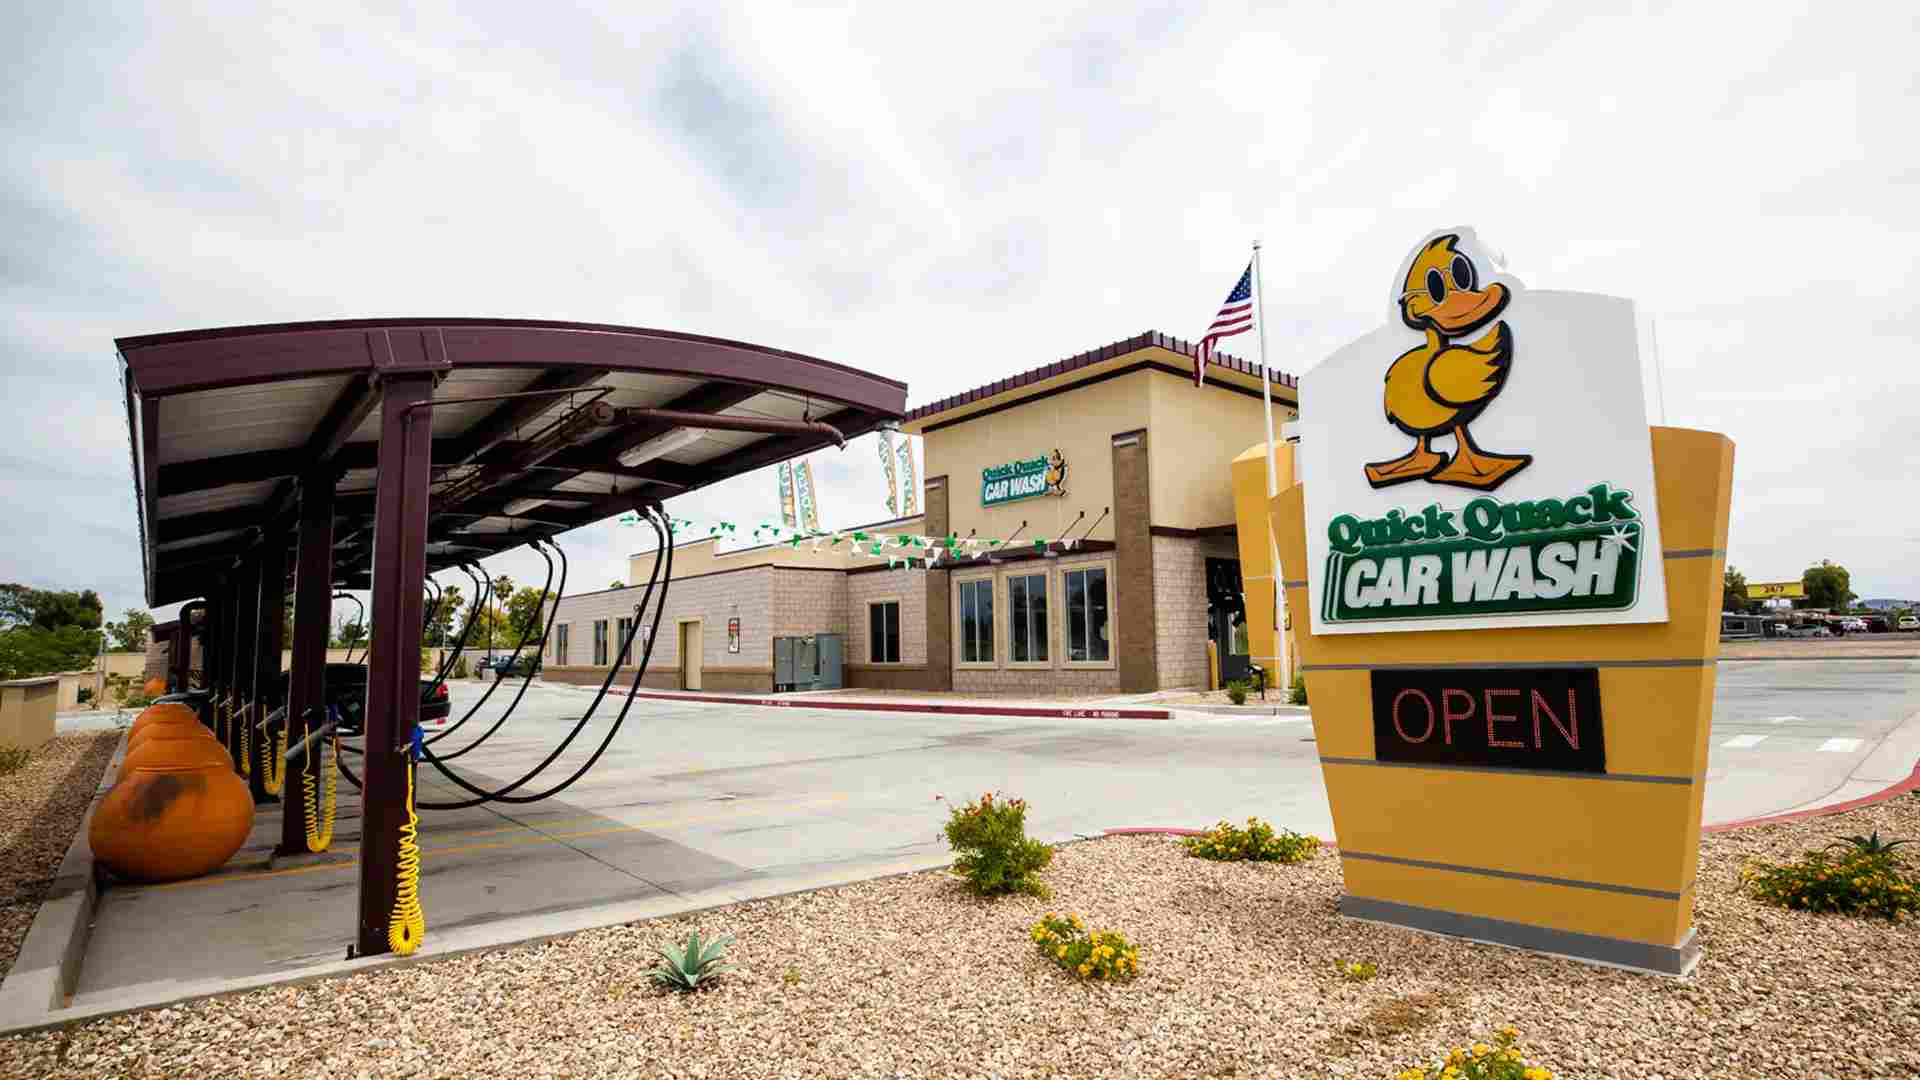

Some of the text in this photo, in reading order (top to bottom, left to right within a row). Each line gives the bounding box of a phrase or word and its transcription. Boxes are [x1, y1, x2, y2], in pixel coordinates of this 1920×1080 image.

[984, 470, 1046, 501] CAR WASH
[1327, 481, 1641, 554] Quick Quack
[1343, 539, 1621, 609] CAR WASH
[1392, 688, 1579, 750] OPEN
